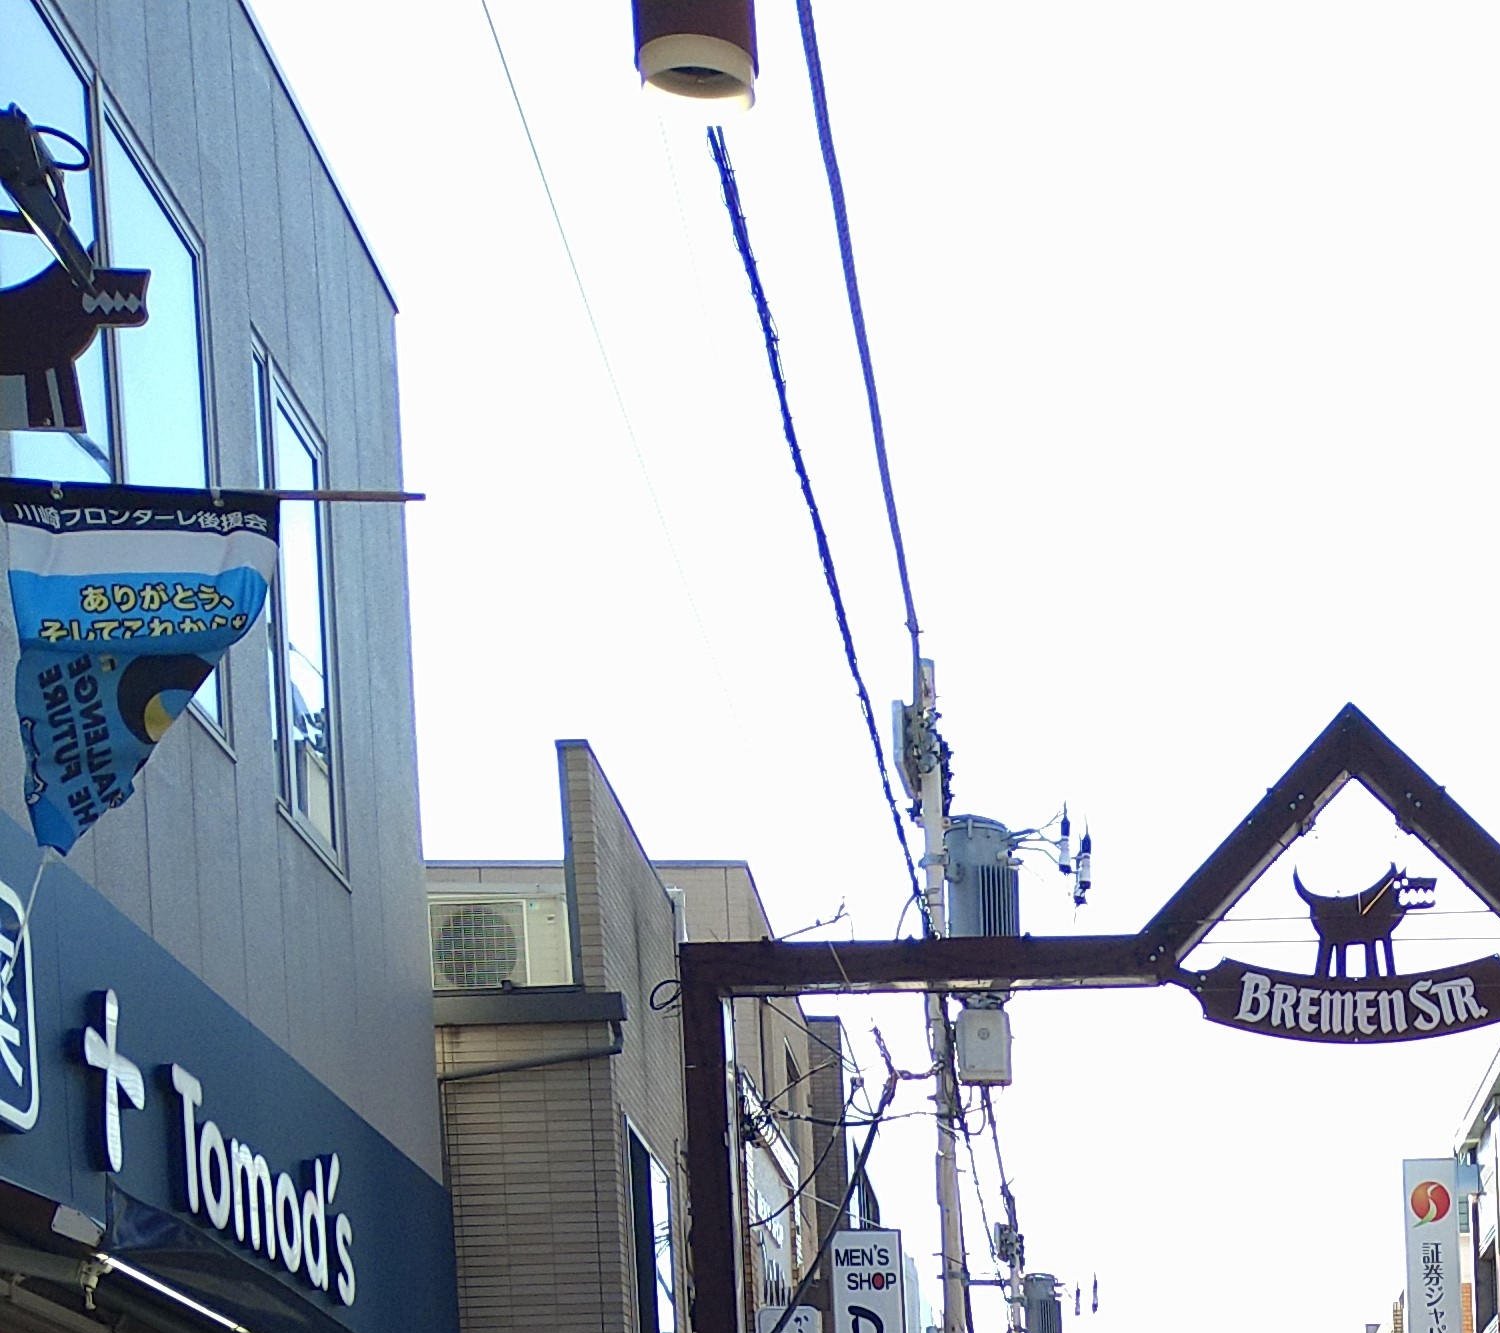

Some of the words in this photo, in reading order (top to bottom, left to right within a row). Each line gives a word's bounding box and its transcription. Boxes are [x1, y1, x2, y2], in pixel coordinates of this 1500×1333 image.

[12, 502, 268, 532] 川崎フロンターレ後援会
[80, 582, 234, 612] ありがとう、
[1234, 971, 1408, 1036] BREMEN
[1412, 976, 1489, 1032] STR.
[172, 1063, 356, 1307] Tomod's
[834, 1244, 890, 1268] MEN'S
[846, 1272, 897, 1291] SHOP
